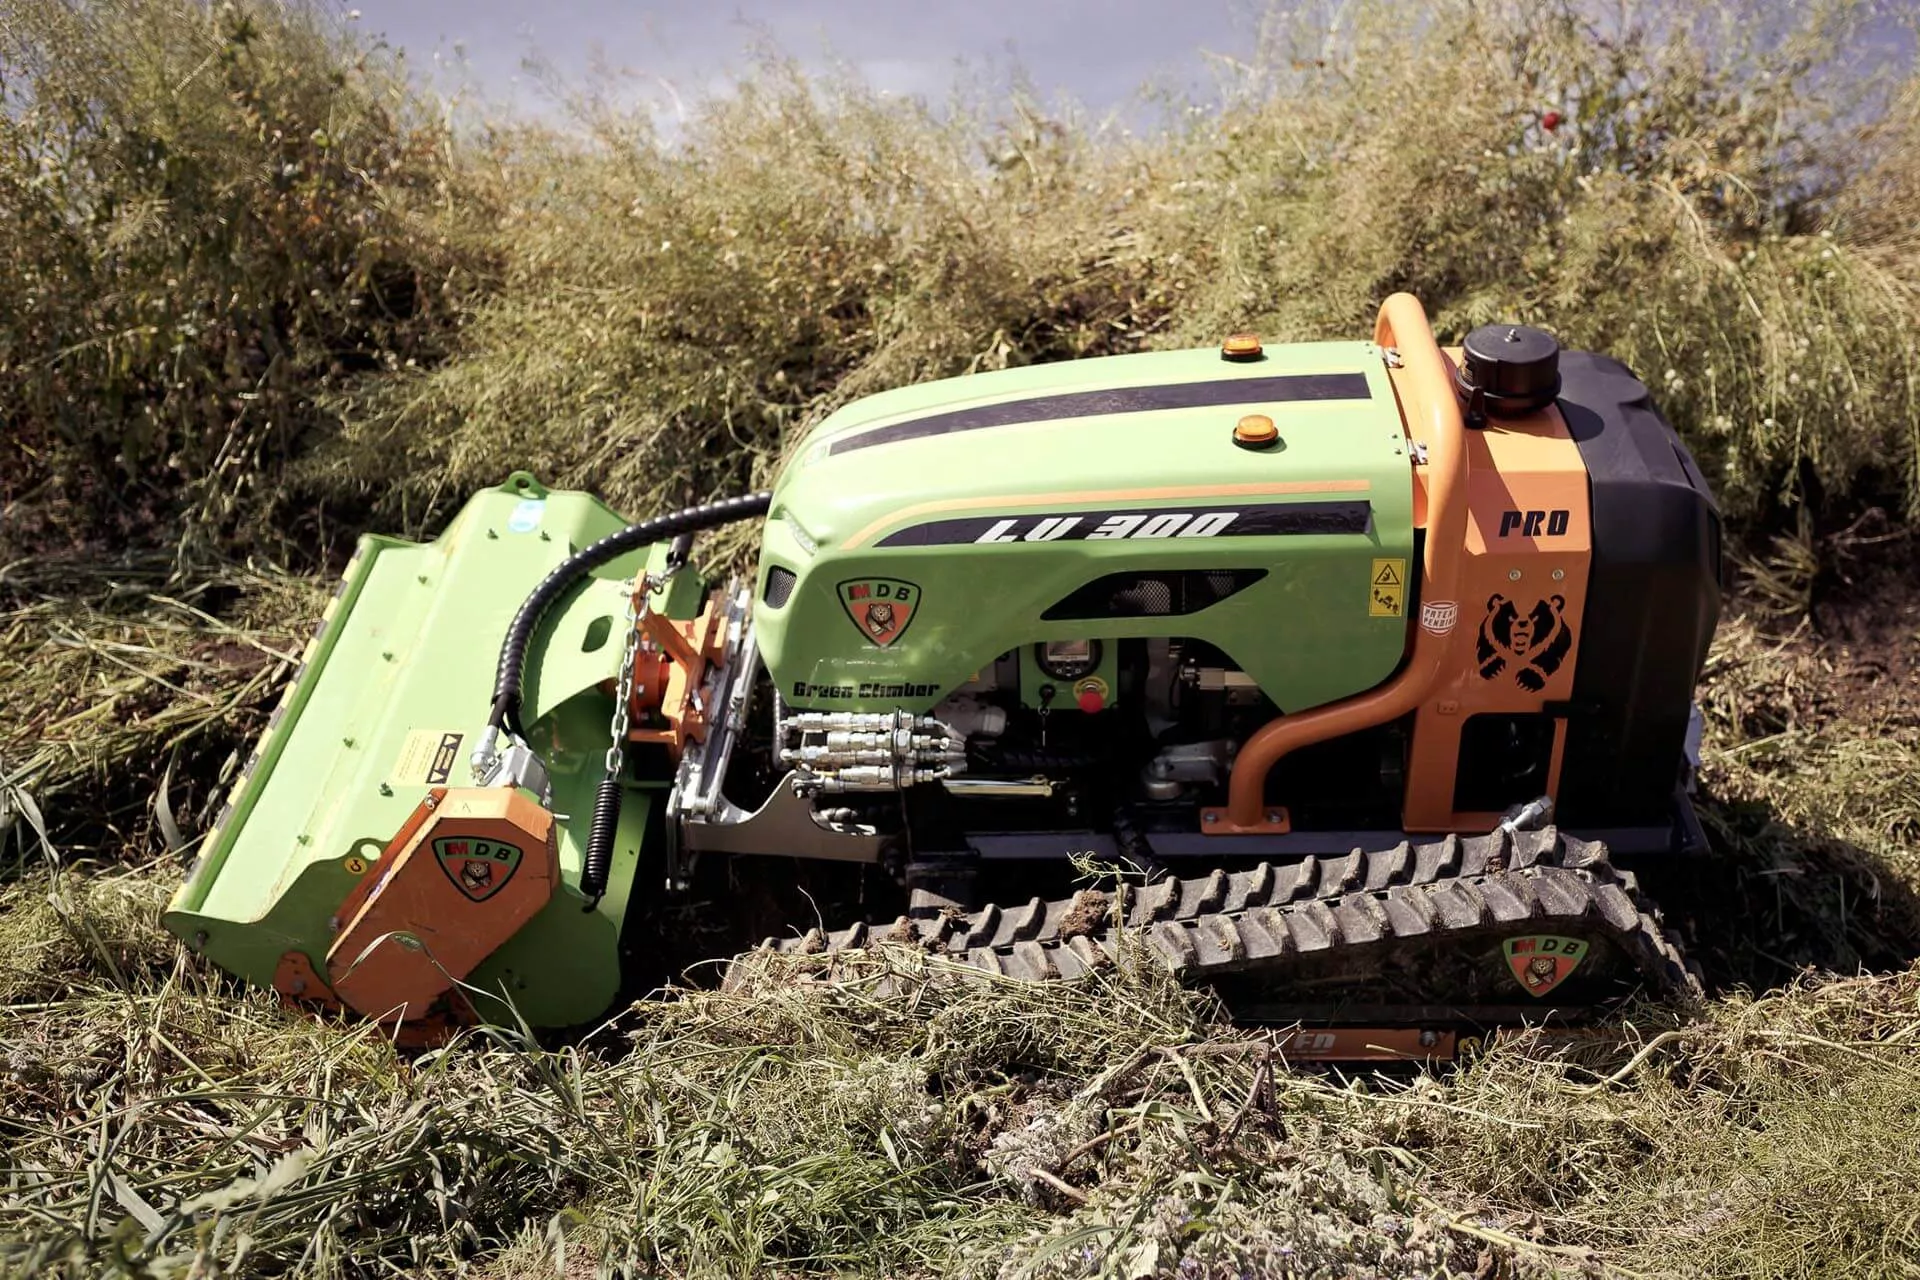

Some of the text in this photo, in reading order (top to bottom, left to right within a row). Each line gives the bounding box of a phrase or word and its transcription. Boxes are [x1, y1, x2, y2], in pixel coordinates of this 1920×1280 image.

[1084, 512, 1240, 540] 300
[1498, 510, 1570, 537] PRO
[793, 682, 940, 698] Green Climber
